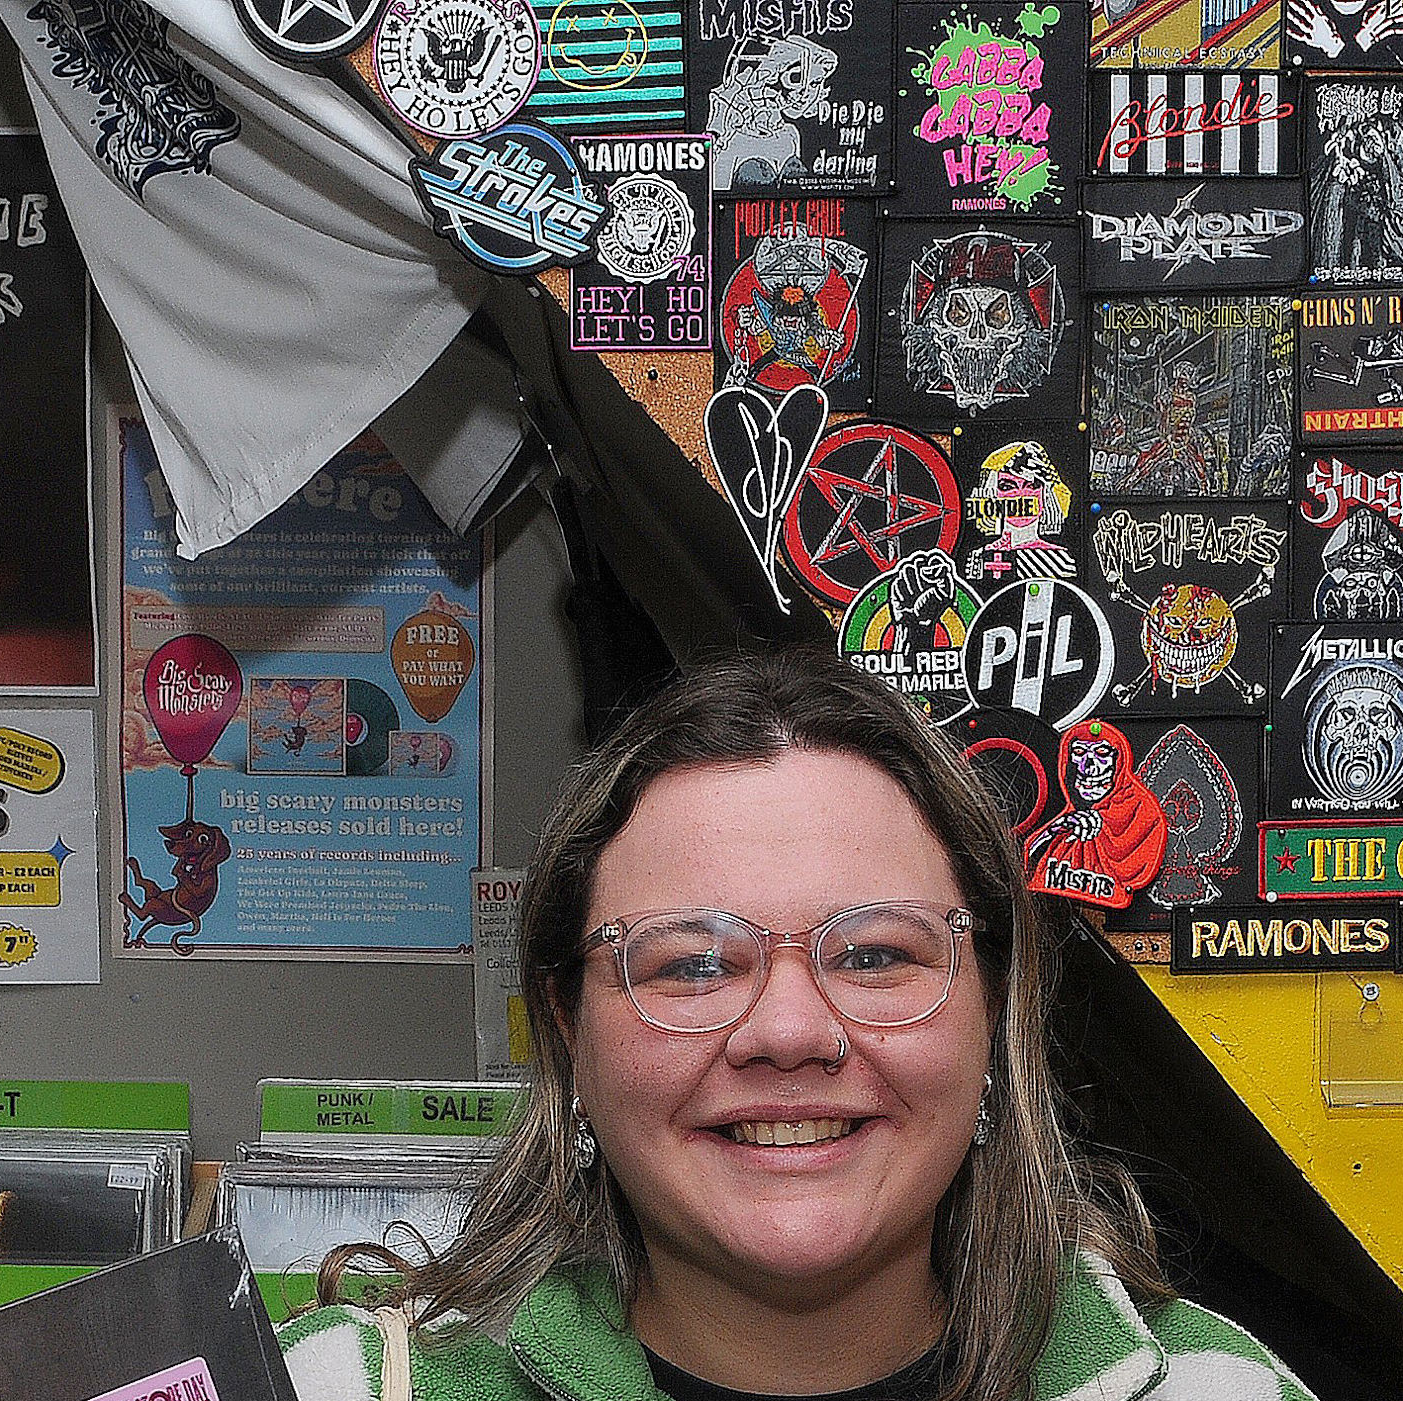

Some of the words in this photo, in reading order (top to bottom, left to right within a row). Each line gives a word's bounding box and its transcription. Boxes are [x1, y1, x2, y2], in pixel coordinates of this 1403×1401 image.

[1100, 46, 1192, 61] TECHNICAL
[1199, 46, 1268, 61] ECSTASY
[496, 140, 547, 178] The
[434, 140, 604, 242] Strokes
[952, 198, 1007, 212] RAMONES
[1085, 206, 1304, 242] DIAMOND
[673, 254, 706, 282] 74
[667, 286, 704, 313] HO
[1302, 296, 1356, 328] GUNS
[577, 315, 655, 342] LET'S
[668, 314, 704, 342] GO
[1103, 304, 1169, 333] IRON
[1181, 304, 1285, 335] MAIDEN
[965, 496, 1036, 521] BLONDIE
[405, 624, 460, 646] FREE
[401, 674, 428, 686] YOU
[430, 674, 465, 686] WANT
[402, 661, 429, 672] PAY
[430, 660, 465, 673] WHAT
[219, 788, 260, 814] big
[265, 791, 334, 814] scary
[343, 789, 463, 812] monsters
[230, 814, 335, 837] releases
[338, 815, 394, 836] sold
[399, 814, 465, 837] here!
[1307, 837, 1386, 883] THE
[1191, 918, 1391, 959] RAMONES
[318, 1092, 365, 1109] PUNK
[421, 1095, 495, 1124] SALE
[316, 1111, 375, 1128] METAL
